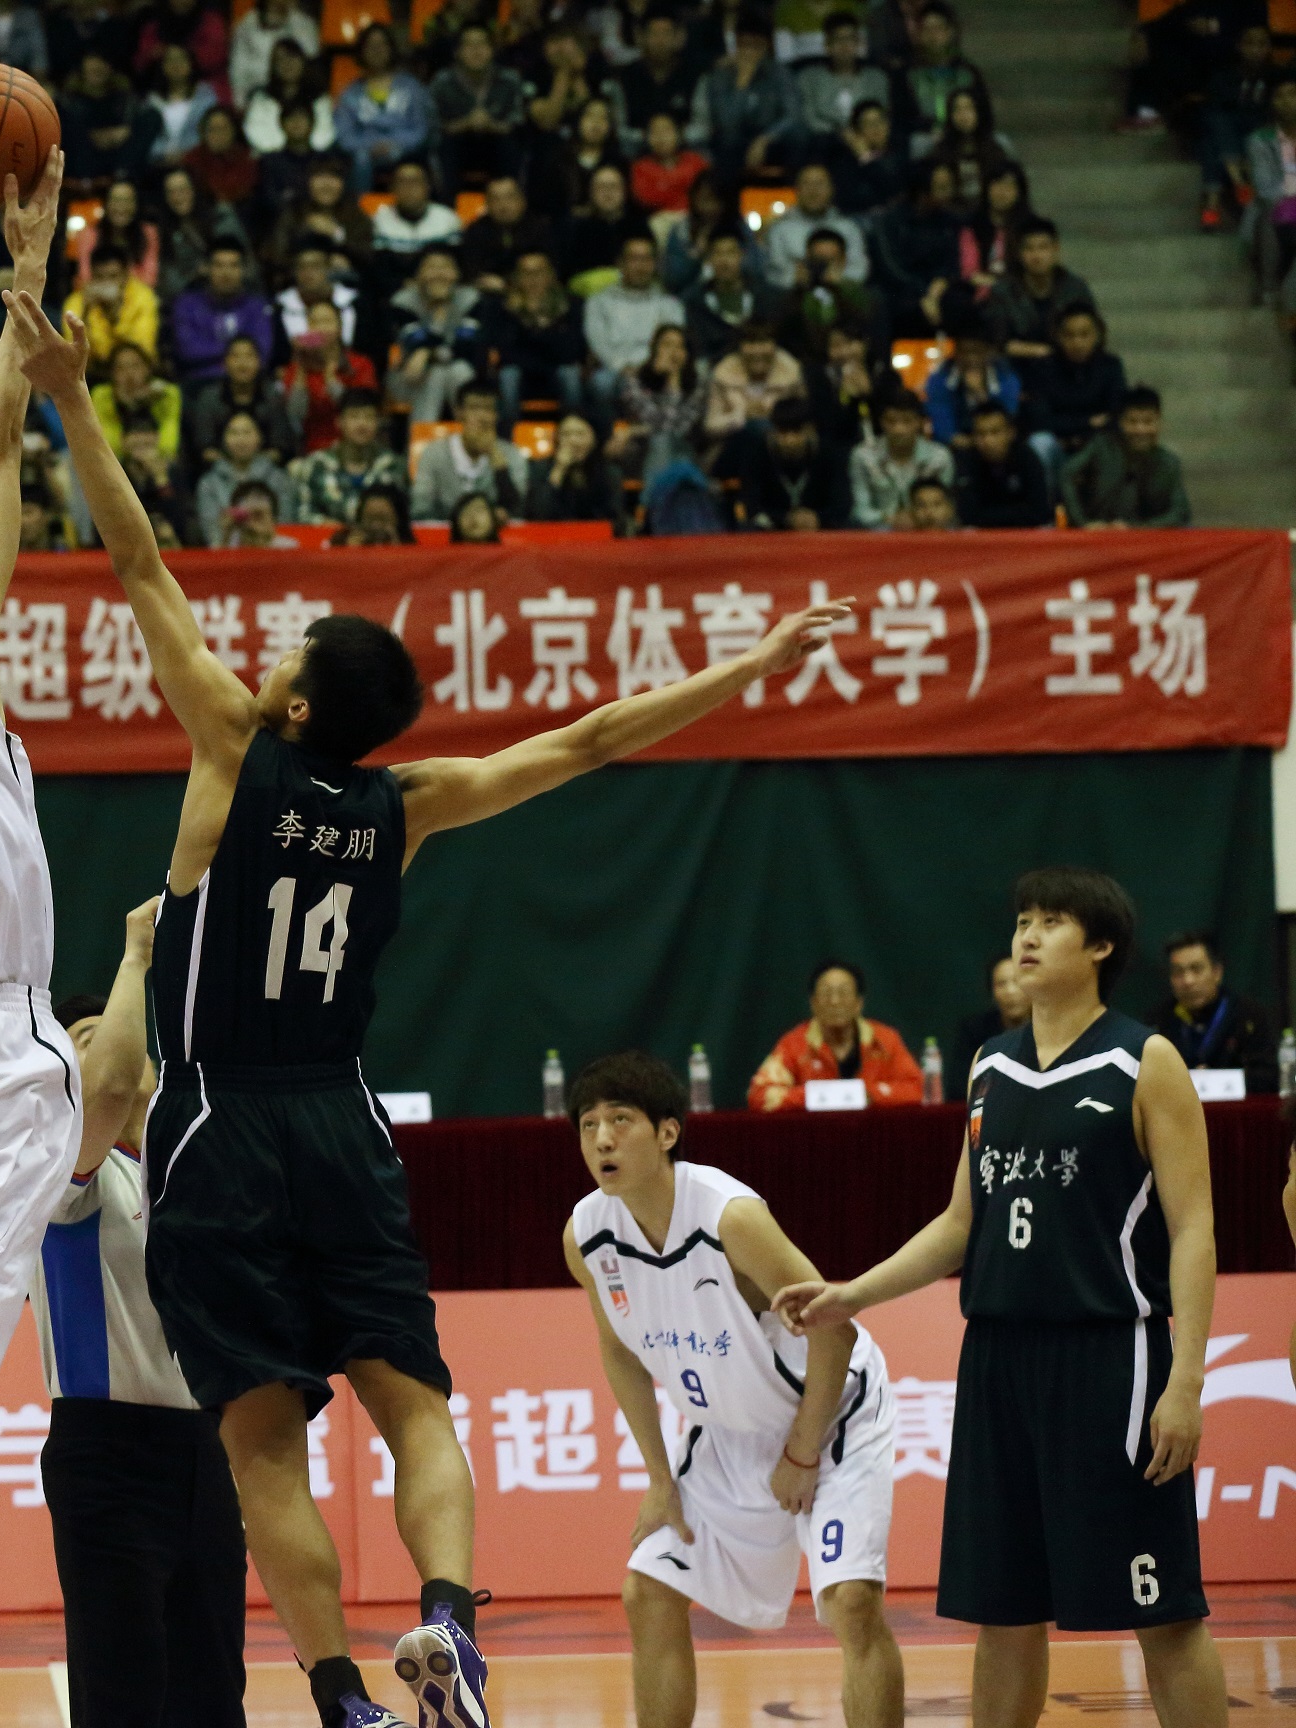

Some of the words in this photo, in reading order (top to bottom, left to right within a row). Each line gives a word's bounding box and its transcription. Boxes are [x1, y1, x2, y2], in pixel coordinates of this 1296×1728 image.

[1044, 573, 1208, 698] 主场
[272, 809, 377, 862] 李建朋
[264, 876, 354, 1004] 14
[1008, 1197, 1034, 1249] 6
[680, 1368, 709, 1409] 9
[820, 1519, 846, 1564] 9
[1130, 1553, 1160, 1607] 6
